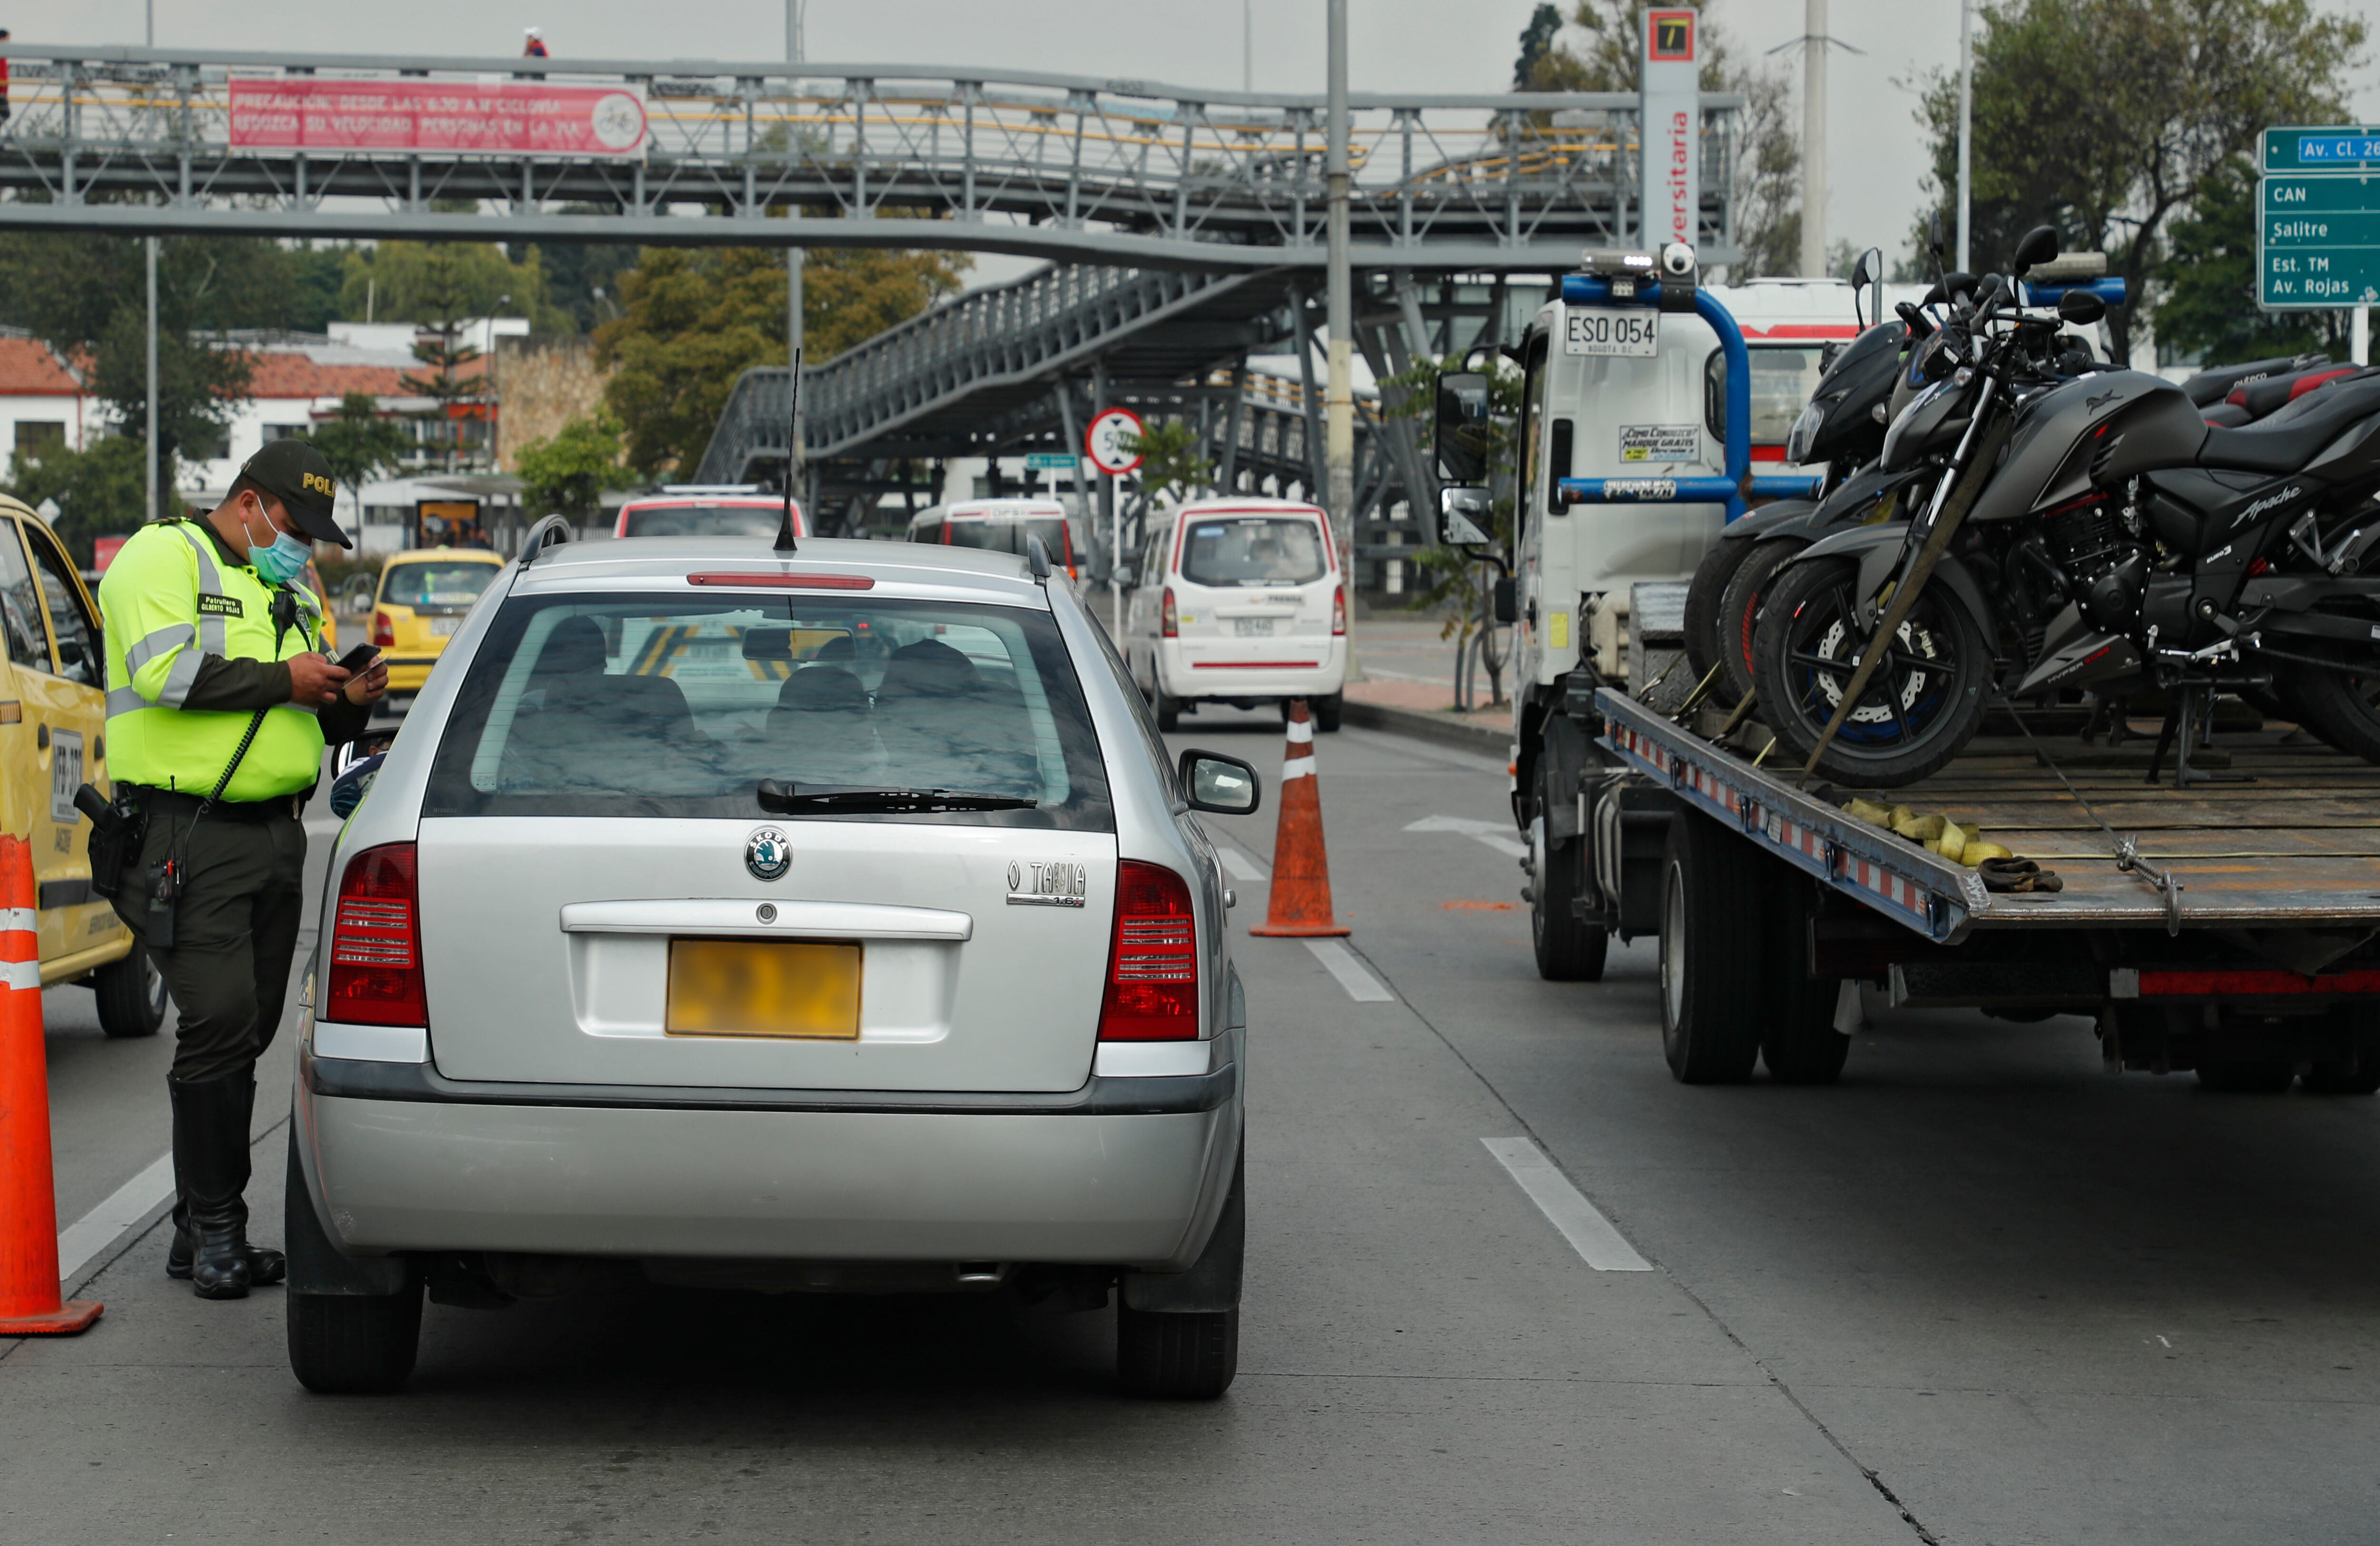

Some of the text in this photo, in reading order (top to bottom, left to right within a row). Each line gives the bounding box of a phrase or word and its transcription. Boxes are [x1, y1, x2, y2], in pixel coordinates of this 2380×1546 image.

[393, 97, 421, 111] LAS
[307, 115, 326, 130] SU
[529, 120, 547, 135] LA
[2305, 142, 2329, 157] Av.
[2274, 187, 2306, 202] CAN
[2274, 221, 2328, 237] Salitre
[2273, 257, 2329, 272] Est. TM
[2273, 278, 2349, 297] Av. Rojas
[1616, 318, 1655, 344] 054
[2230, 485, 2302, 529] Apache
[201, 603, 240, 614] GILBERTO ROJAS
[206, 597, 236, 607] Patrullero
